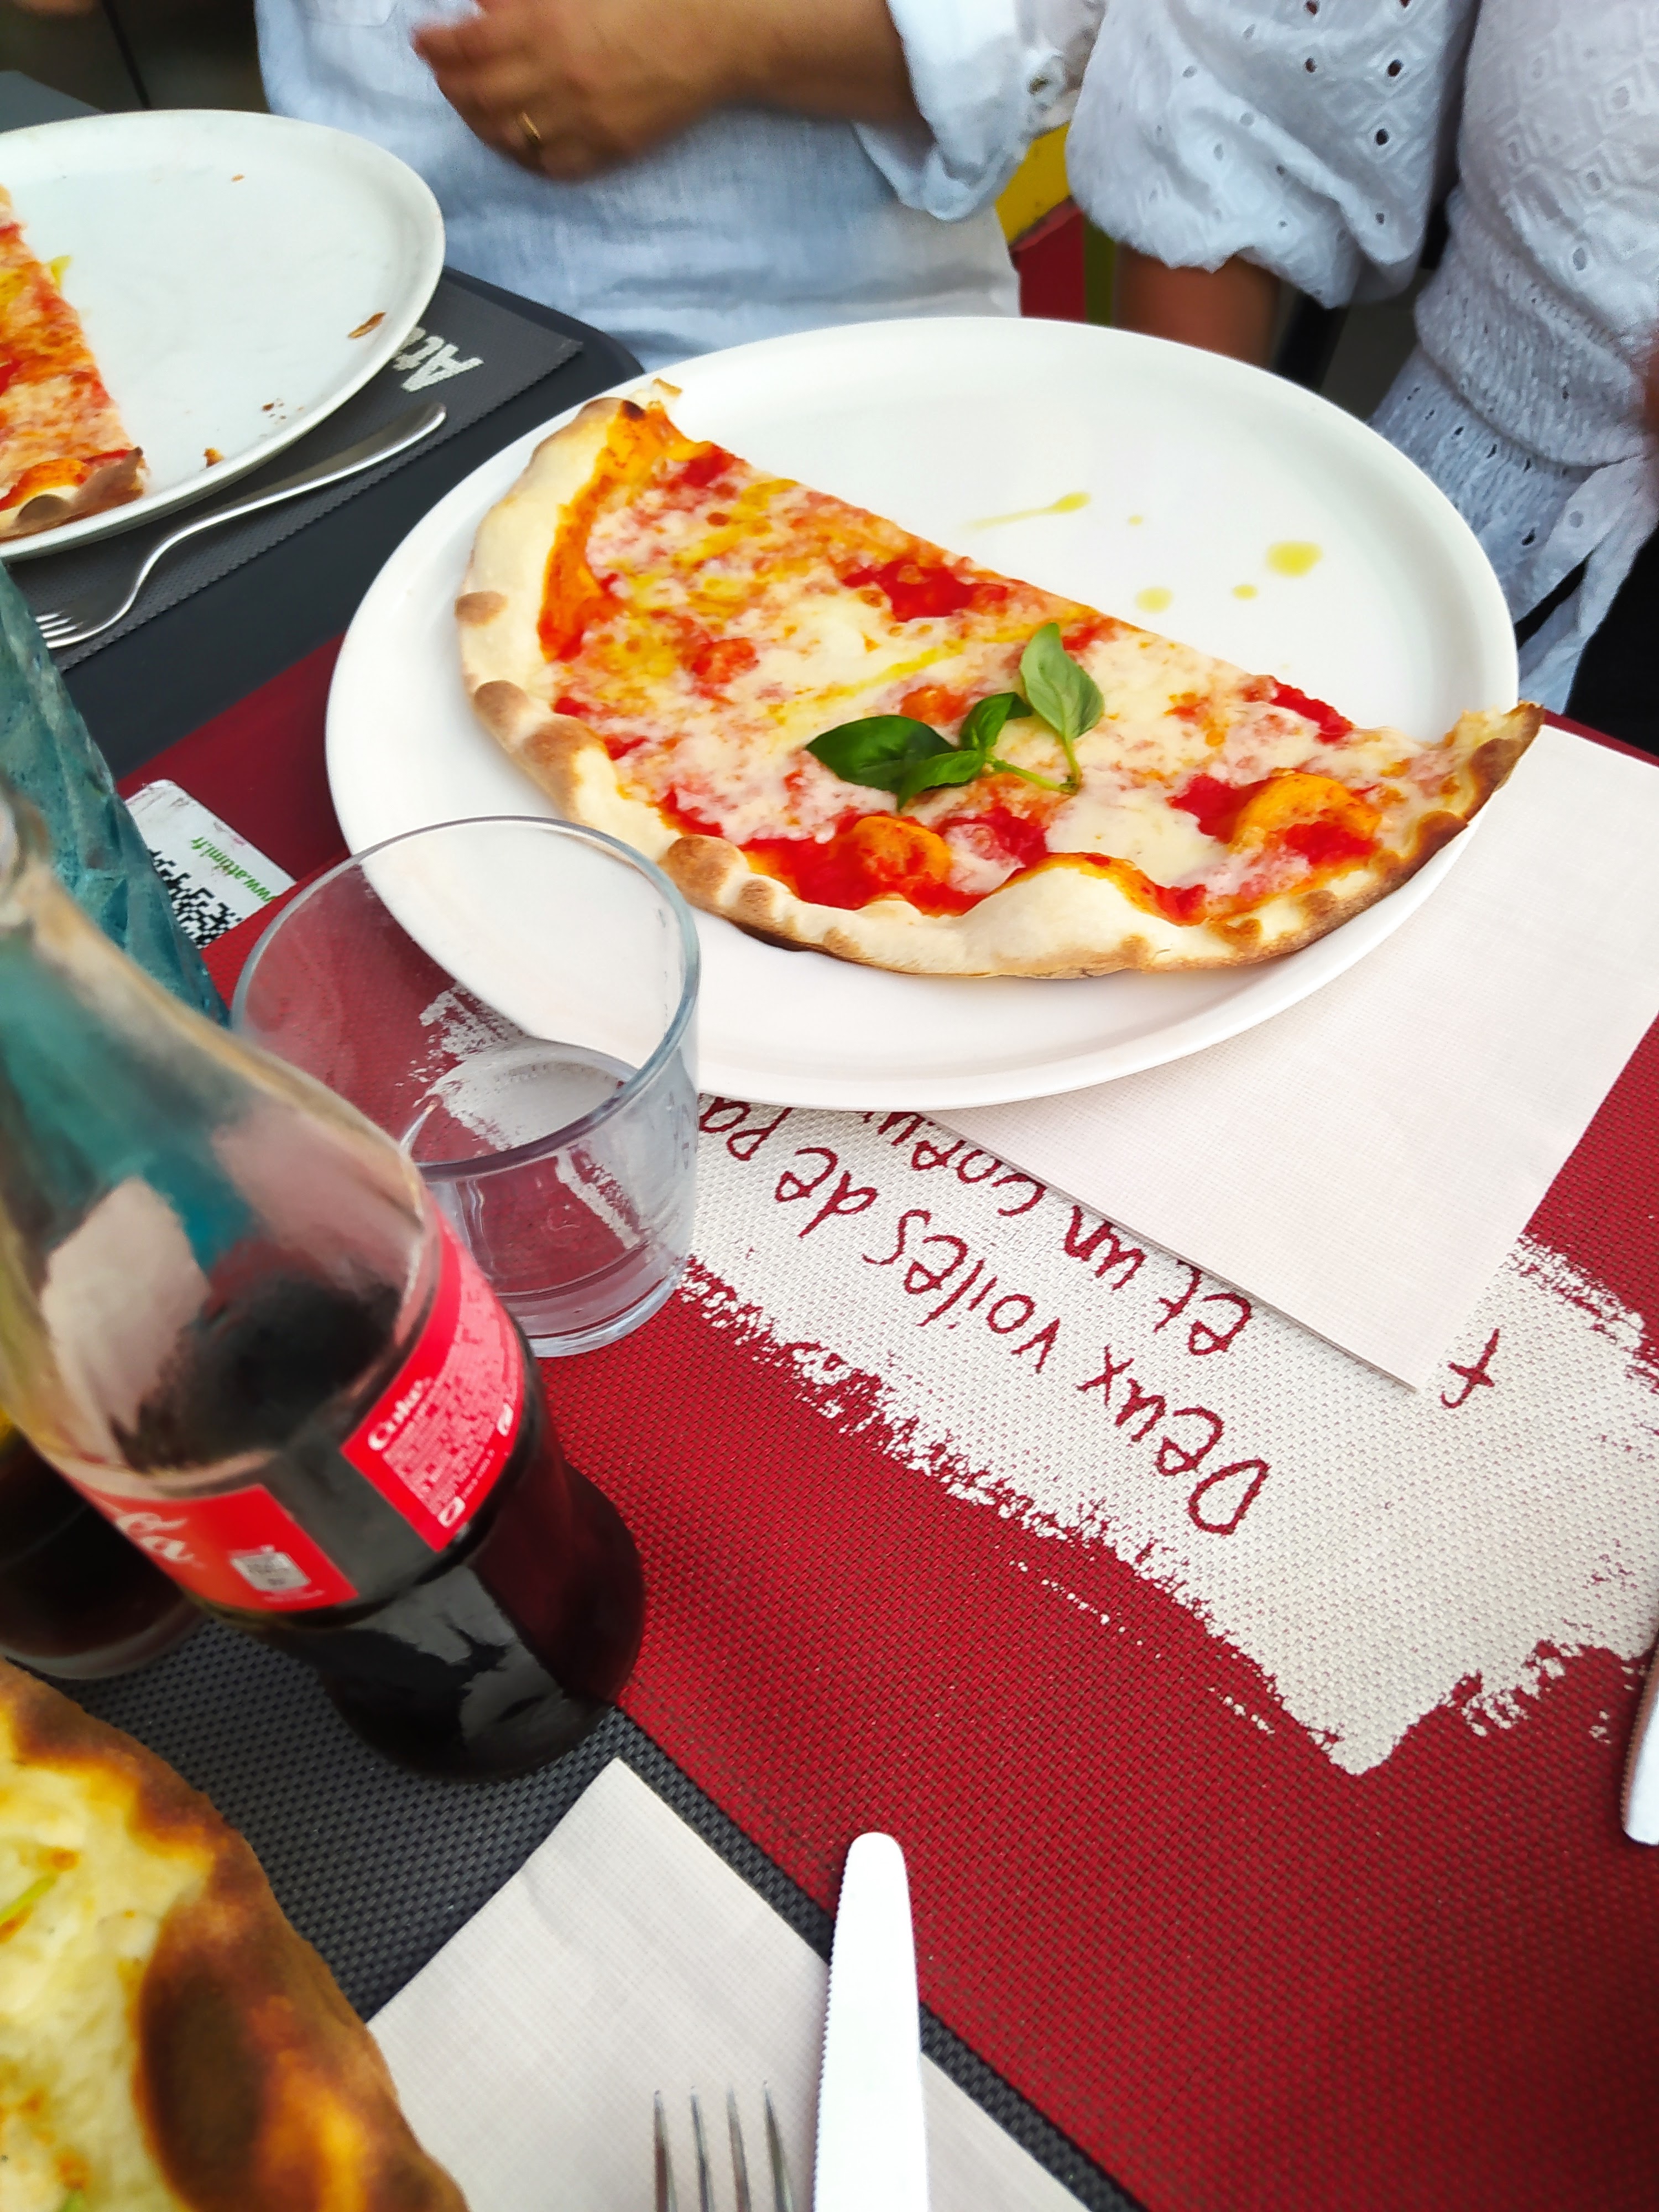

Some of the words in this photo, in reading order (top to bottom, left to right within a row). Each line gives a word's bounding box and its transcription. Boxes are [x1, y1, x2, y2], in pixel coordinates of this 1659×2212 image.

[699, 1093, 794, 1161] pa
[862, 1110, 1047, 1218] coeu
[775, 1147, 878, 1238] de
[862, 1209, 1061, 1373] voiles
[1063, 1204, 1146, 1290] un
[1153, 1260, 1253, 1355] et
[1076, 1346, 1270, 1536] Deux
